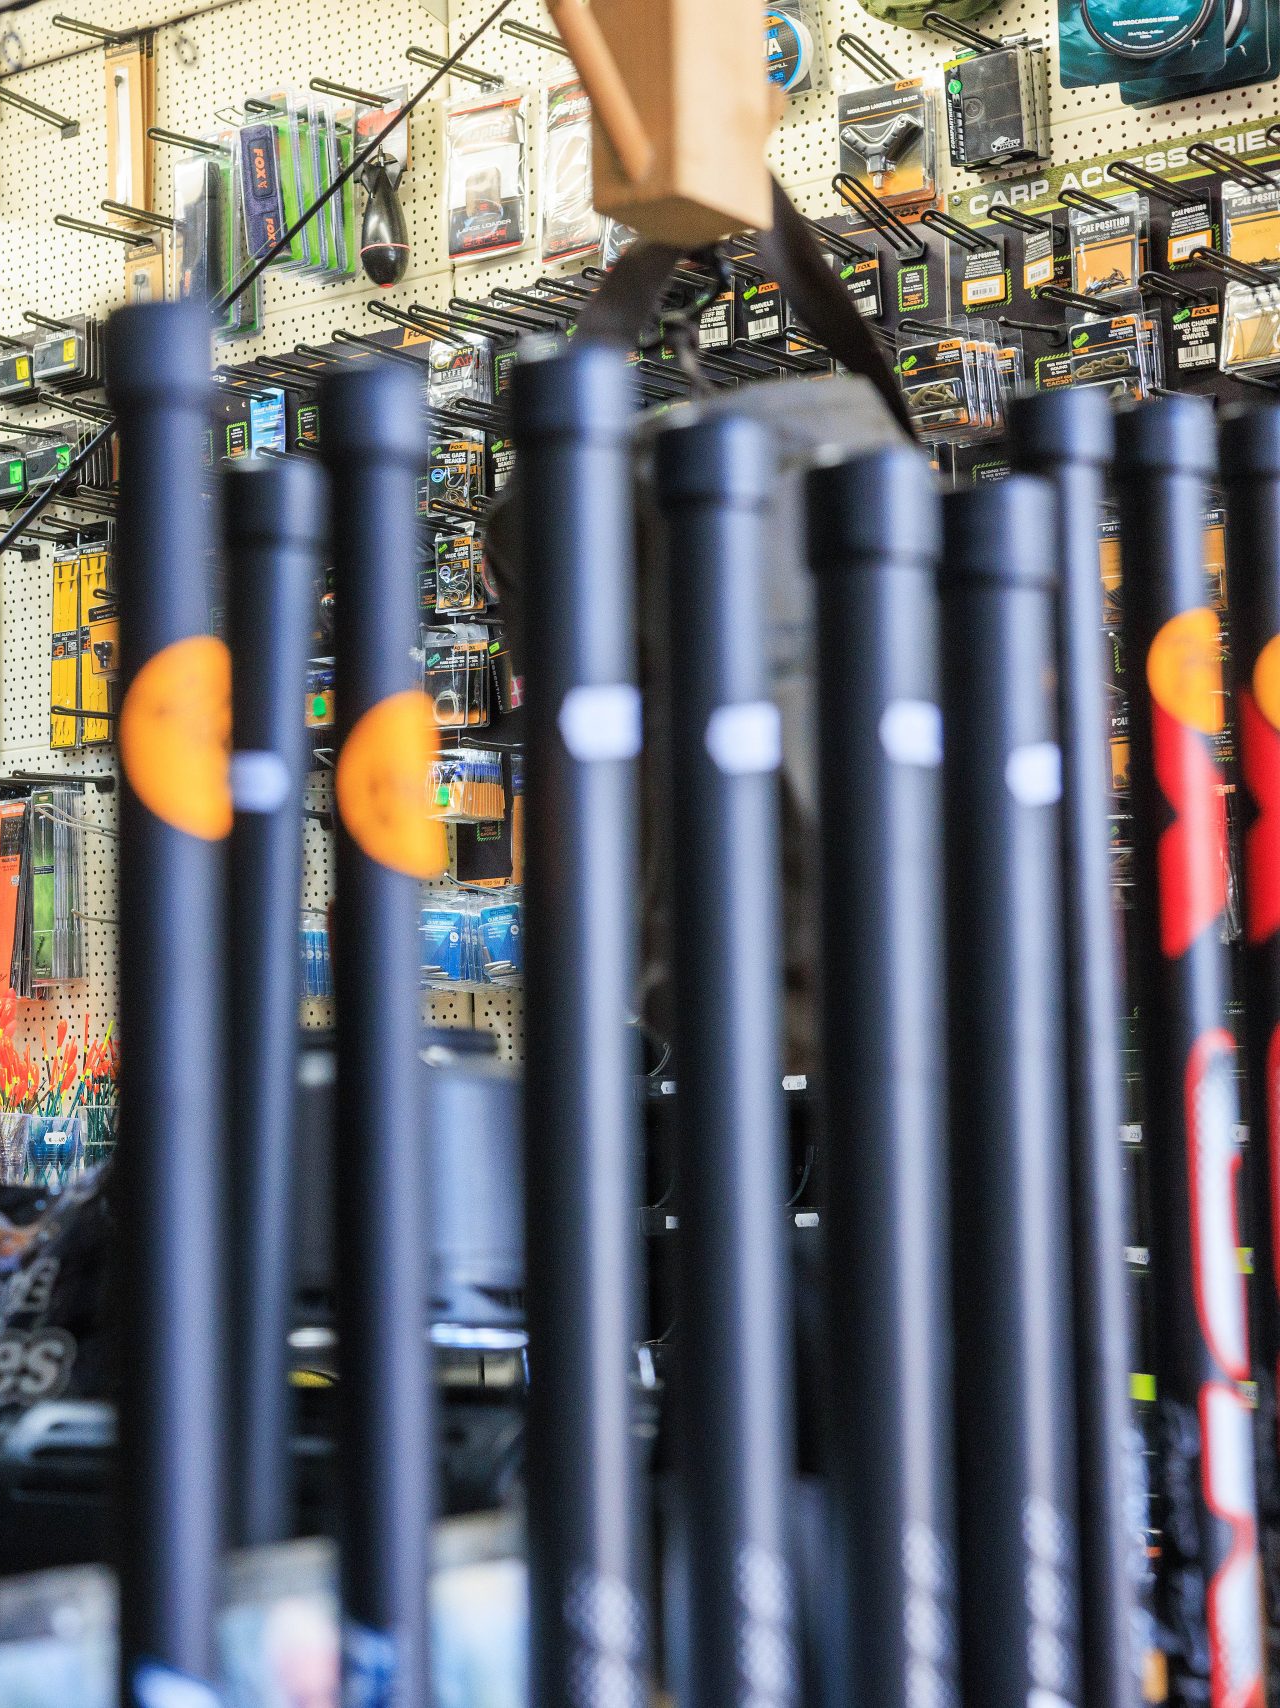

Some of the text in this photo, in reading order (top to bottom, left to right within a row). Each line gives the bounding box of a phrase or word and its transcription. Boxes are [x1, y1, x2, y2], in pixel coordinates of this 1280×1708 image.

[1112, 15, 1180, 27] FLUOROCARBON HYBRID
[897, 80, 914, 89] FOX
[871, 101, 892, 109] LANDING
[947, 99, 956, 149] COMPARTMENT
[253, 148, 268, 179] FOX
[970, 180, 1050, 214] CARP
[1232, 196, 1253, 208] POLE
[1171, 203, 1207, 218] POLE POSITION
[265, 218, 277, 241] FOX
[458, 218, 512, 236] LARGE LOADER
[1076, 216, 1130, 235] POLE POSITION
[977, 250, 1000, 261] POSITION
[847, 279, 872, 291] SWIVELS
[750, 300, 774, 311] SWIVELS
[1173, 318, 1217, 331] KWIK CHANGE
[1192, 325, 1208, 333] RING
[1182, 331, 1210, 341] SWIVELS
[436, 451, 466, 460] WIDE GAPE
[444, 457, 466, 465] BEAKED
